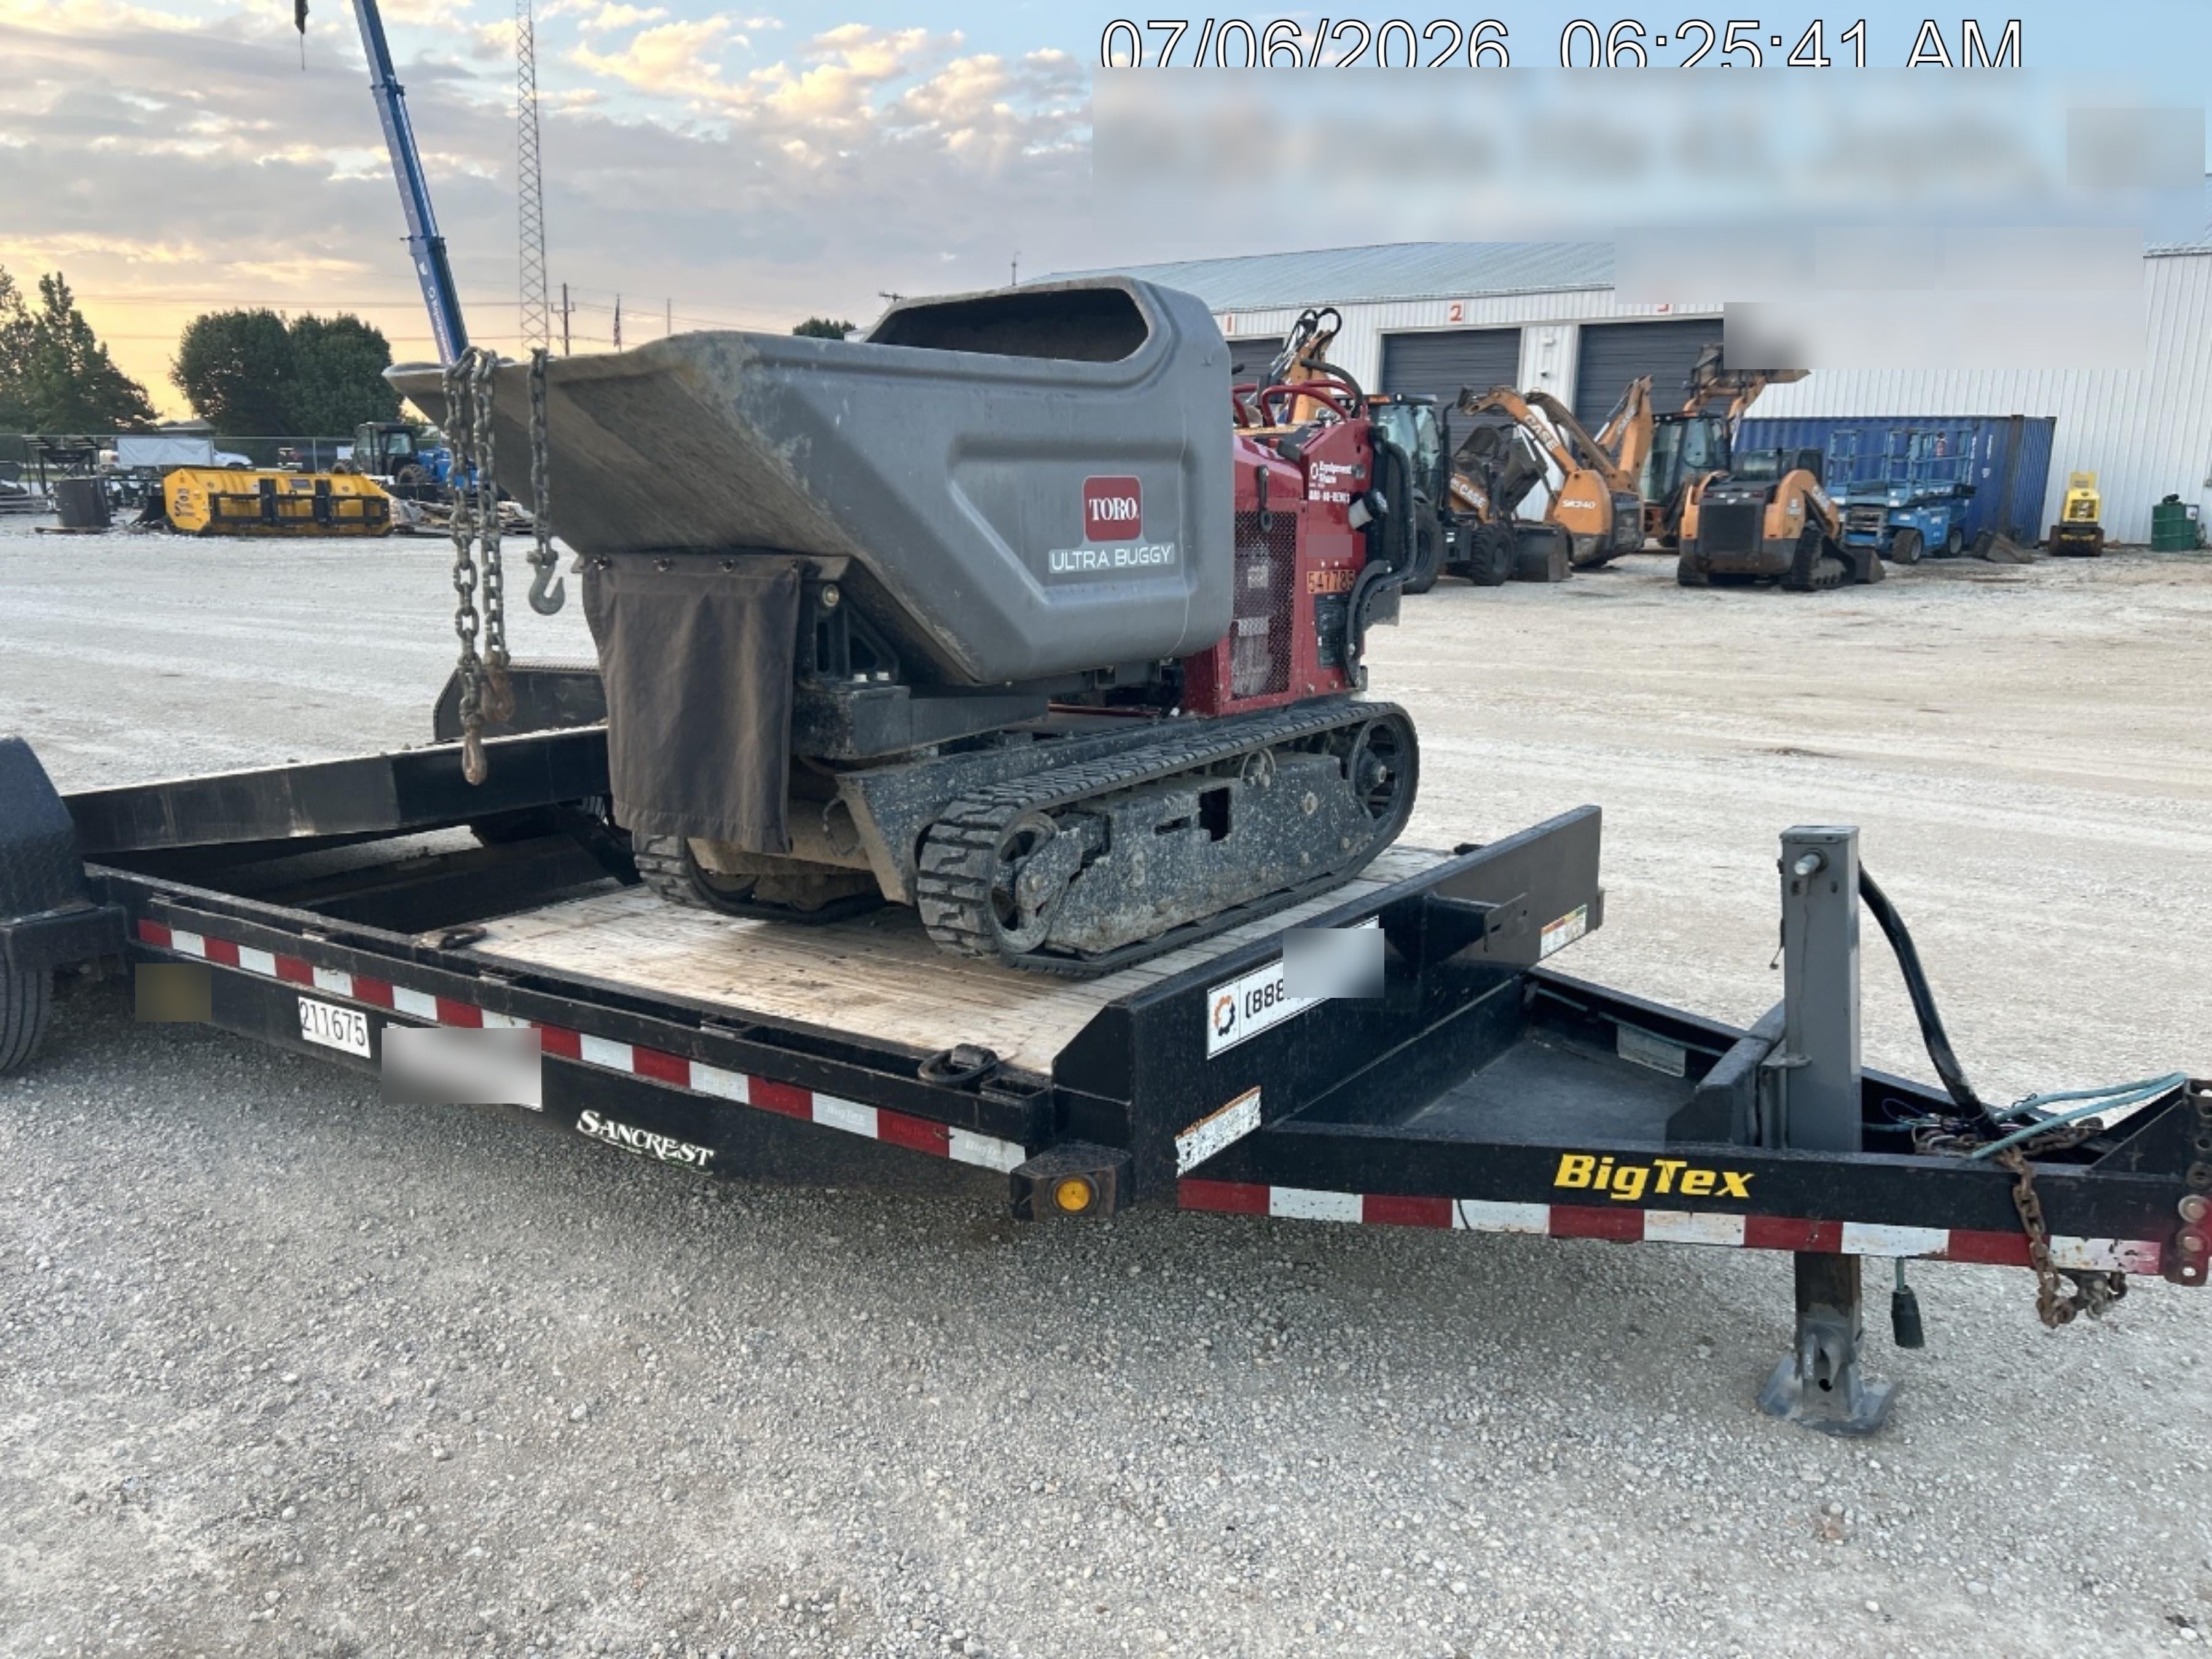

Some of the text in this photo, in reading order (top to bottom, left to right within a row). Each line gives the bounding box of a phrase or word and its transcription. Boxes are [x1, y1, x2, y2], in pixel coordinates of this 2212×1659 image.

[1449, 304, 1464, 321] 2
[1524, 414, 1559, 452] CASE
[1089, 496, 1138, 520] TORO
[1051, 545, 1172, 571] ULTRA BUGGY
[1245, 978, 1290, 1019] (888
[299, 1000, 366, 1047] 211675
[576, 1109, 715, 1166] SANCREST
[1553, 1153, 1755, 1201] BigTex
